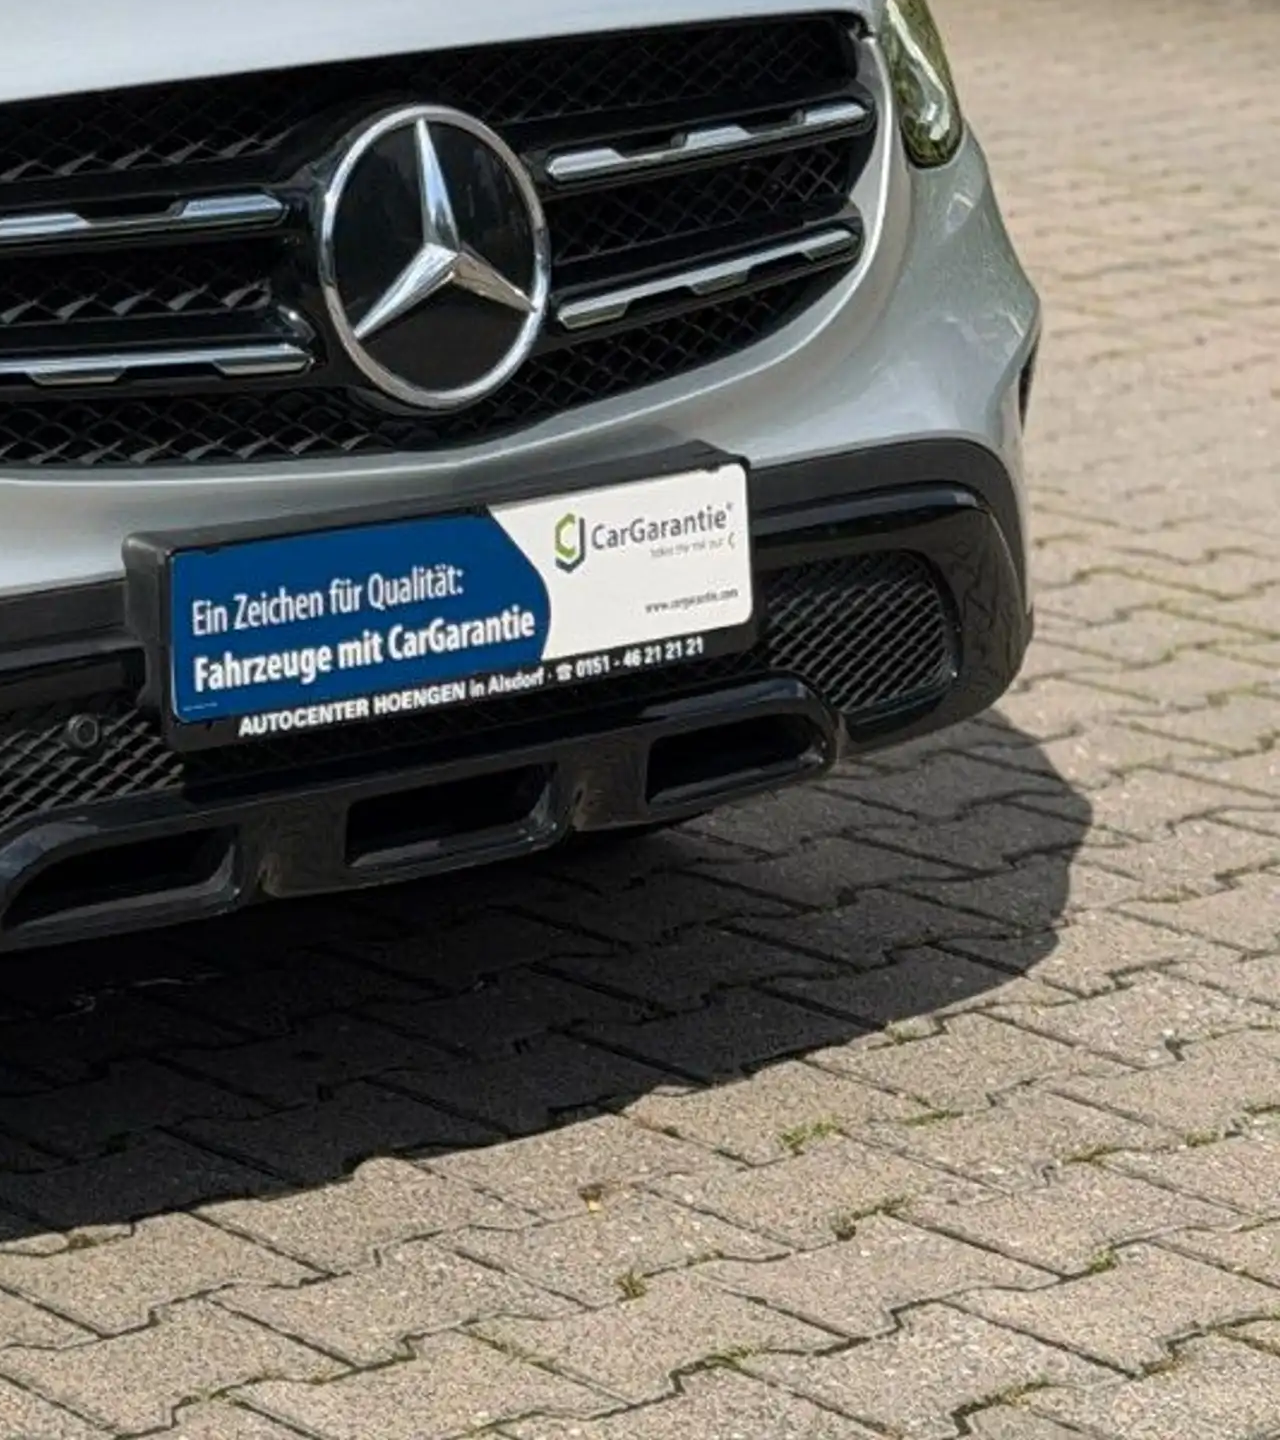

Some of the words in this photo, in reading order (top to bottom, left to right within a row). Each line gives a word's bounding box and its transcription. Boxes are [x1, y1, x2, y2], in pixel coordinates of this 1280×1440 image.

[591, 505, 728, 551] CarGarantie
[192, 599, 228, 636] Ein
[233, 585, 324, 631] Zeichen
[329, 577, 363, 615] für
[367, 563, 464, 610] Qualität:
[194, 650, 333, 693] Fahrzeuge
[337, 628, 384, 669] mit
[388, 603, 536, 661] CarGarantie
[238, 697, 370, 737] AUTOCENTER
[373, 680, 467, 715] HOENGEN
[469, 679, 485, 698] in
[487, 666, 545, 695] Alsdorf
[575, 654, 611, 678] 0151
[623, 647, 642, 668] 46
[644, 644, 662, 665] 21
[665, 640, 683, 660] 21
[685, 635, 705, 657] 21
